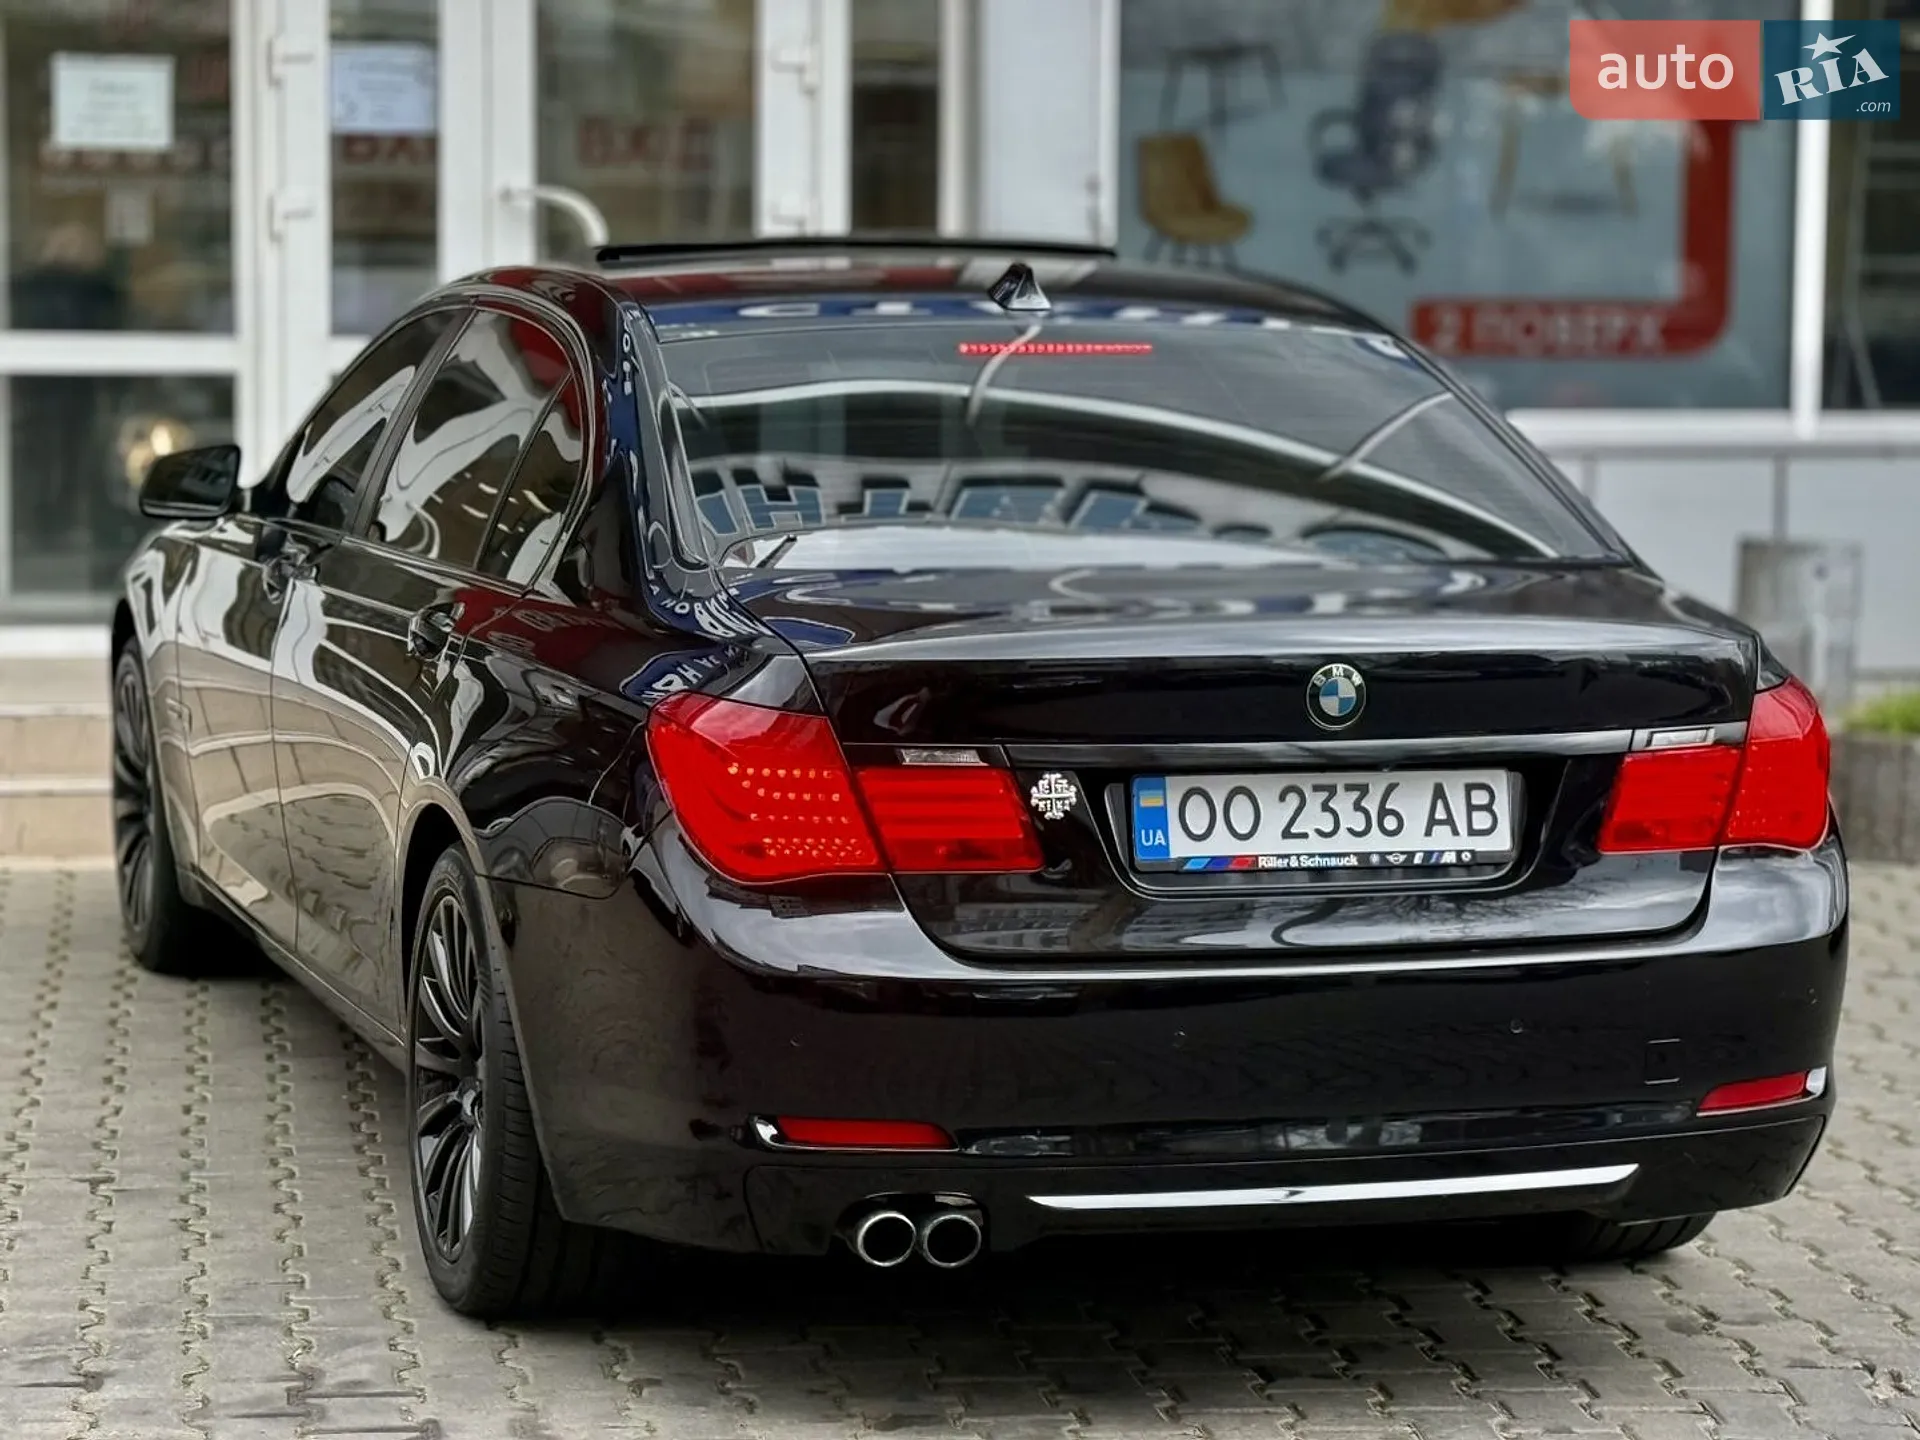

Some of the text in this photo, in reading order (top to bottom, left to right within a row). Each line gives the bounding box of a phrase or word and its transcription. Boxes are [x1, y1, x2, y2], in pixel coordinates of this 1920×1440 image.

[1313, 665, 1362, 687] BMW
[1178, 782, 1498, 842] OO 2336 AB
[1141, 829, 1166, 846] UA
